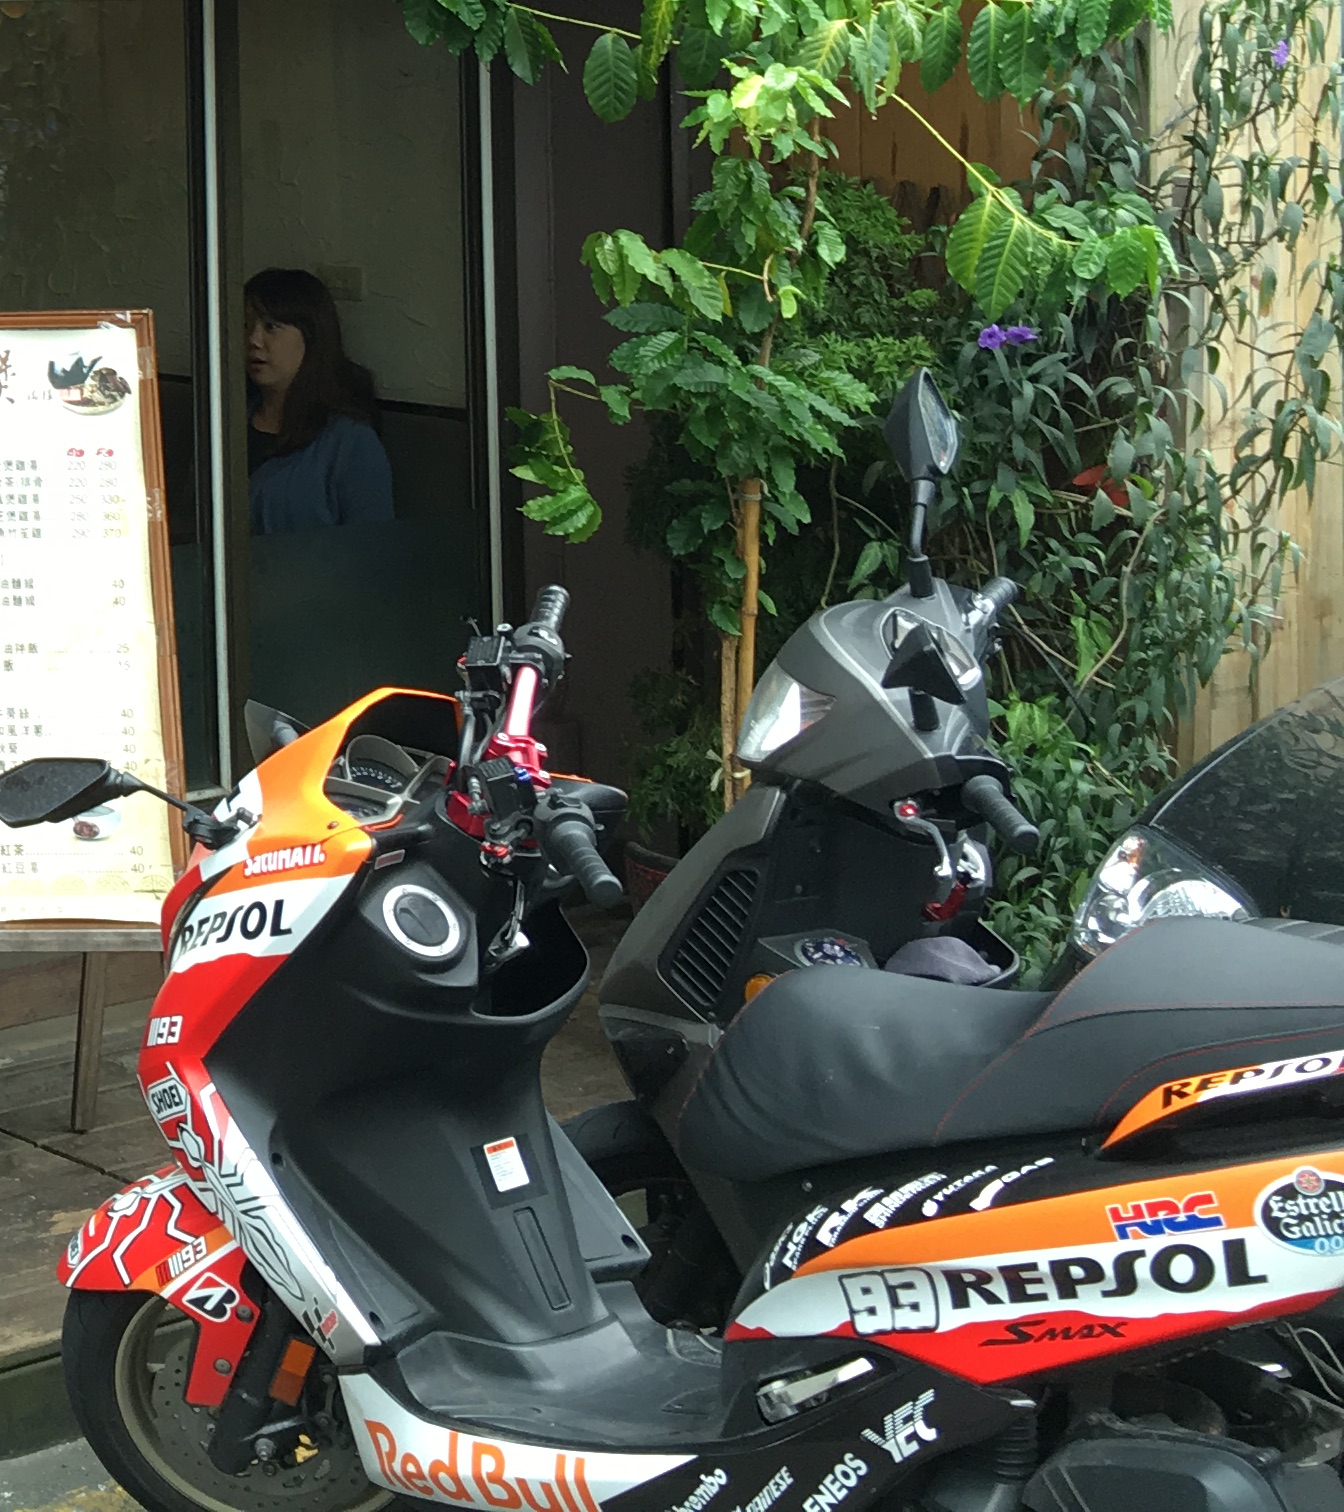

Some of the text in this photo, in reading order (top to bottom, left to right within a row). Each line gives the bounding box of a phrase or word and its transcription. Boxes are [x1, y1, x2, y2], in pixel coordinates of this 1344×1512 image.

[0, 844, 144, 856] 紅茶 40
[131, 863, 145, 873] 40
[178, 898, 293, 954] REPSOL
[152, 1084, 184, 1115] SHOEI
[1161, 1057, 1344, 1110] REPSO
[1108, 1192, 1225, 1242] HRC
[840, 1237, 1269, 1336] 93 REPSOL
[364, 1418, 604, 1512] Red Bull
